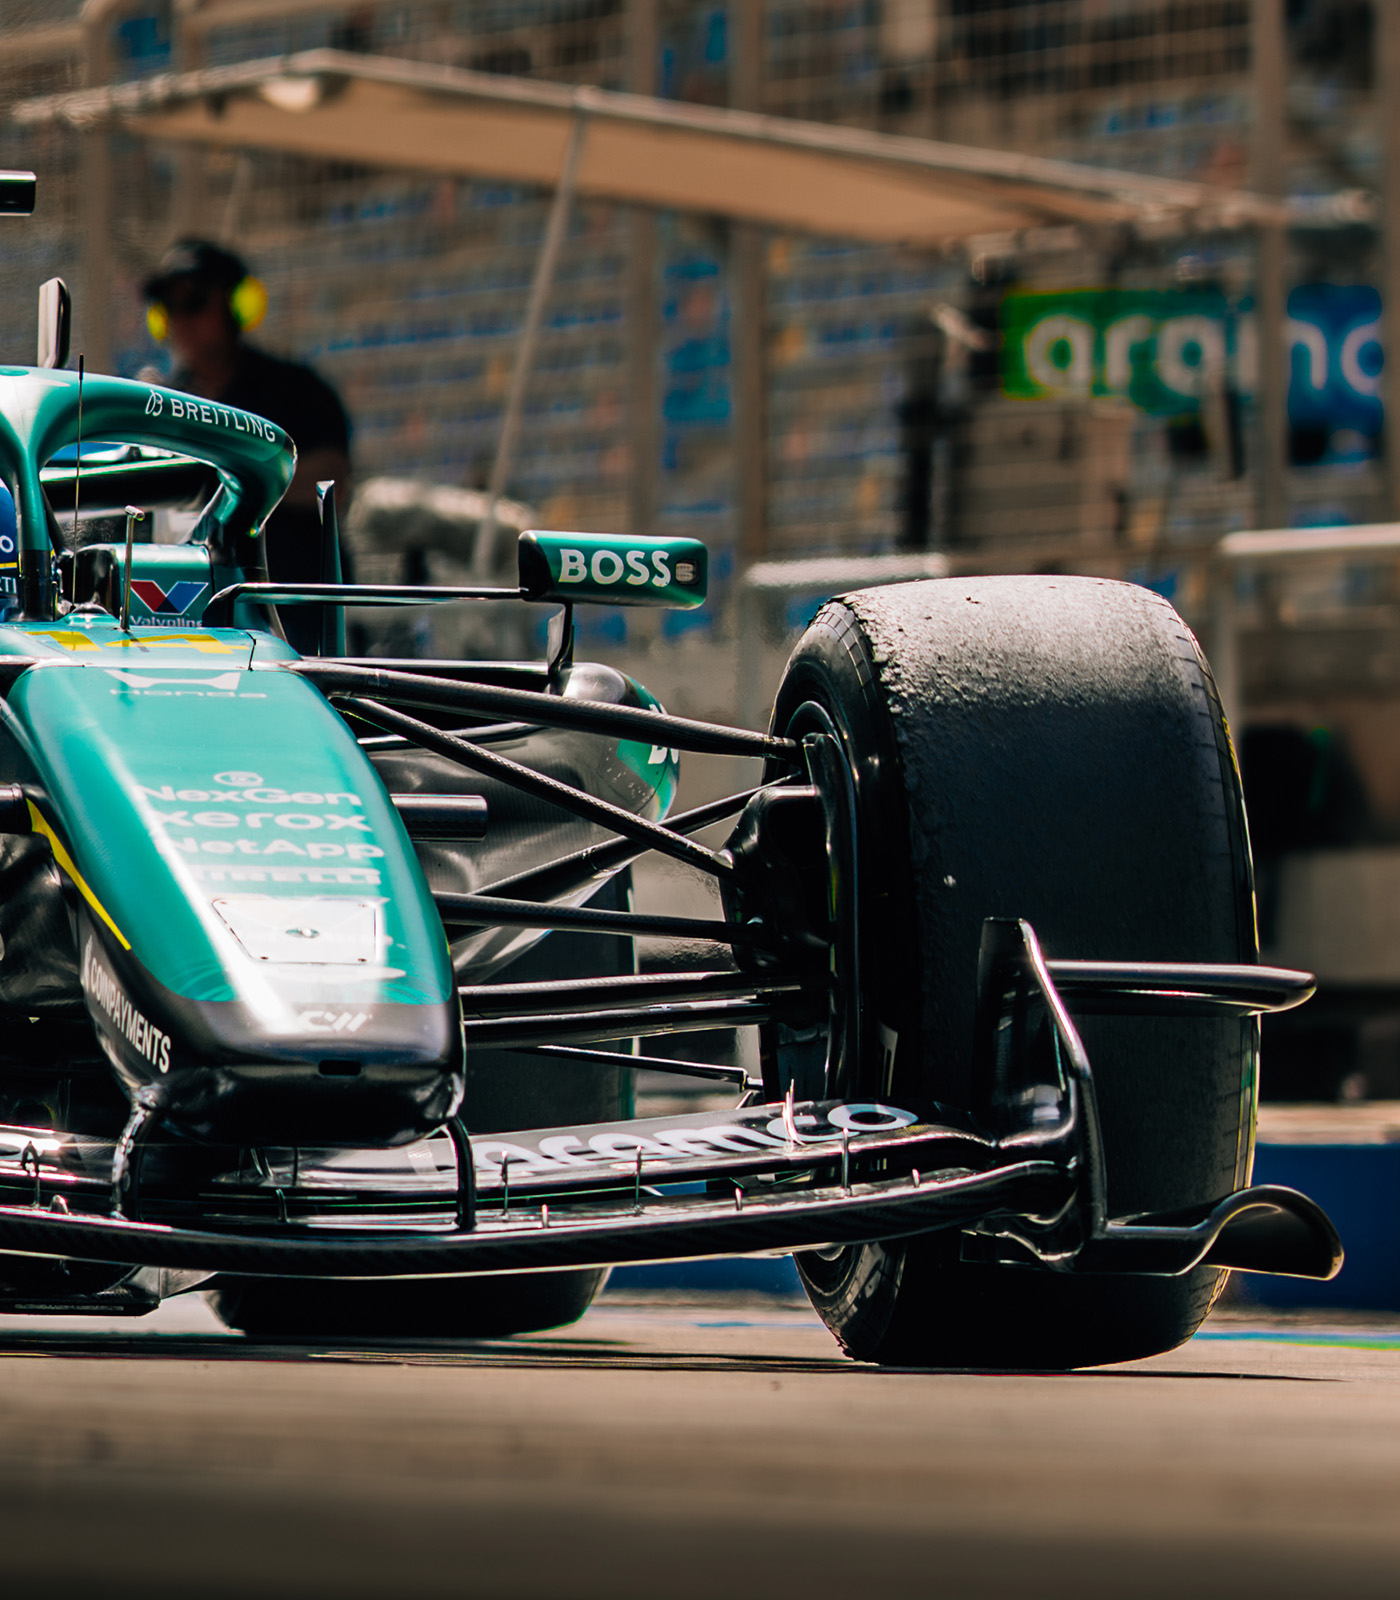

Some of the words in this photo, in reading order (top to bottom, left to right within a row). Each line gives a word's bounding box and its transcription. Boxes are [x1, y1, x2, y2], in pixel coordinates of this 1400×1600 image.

[171, 398, 275, 442] BREITLING
[558, 549, 671, 587] BOSS
[23, 630, 250, 654] 14
[134, 785, 362, 806] NexGen
[153, 810, 373, 831] xerox
[166, 837, 384, 860] NetApp
